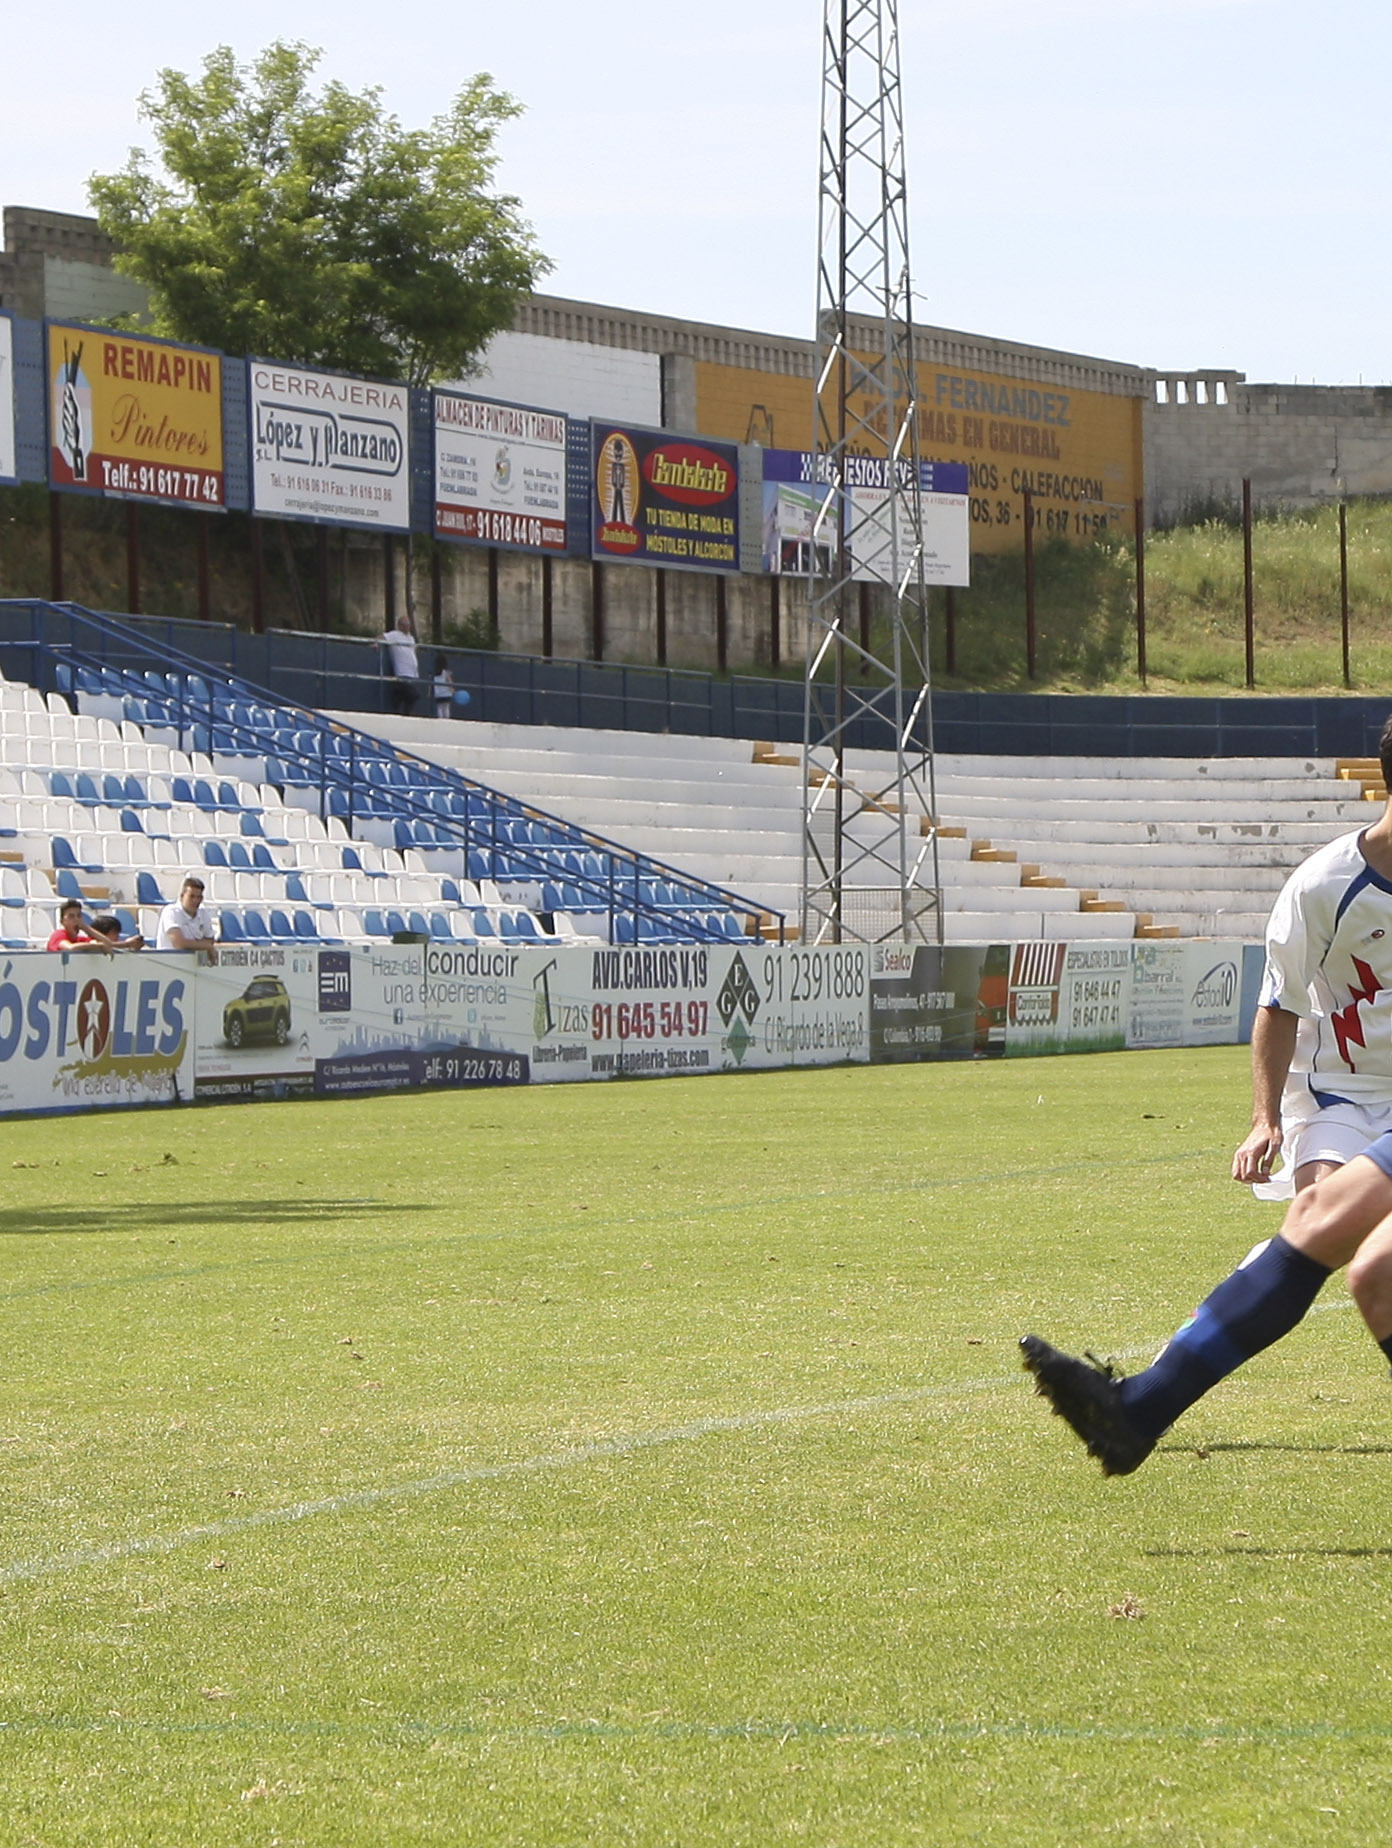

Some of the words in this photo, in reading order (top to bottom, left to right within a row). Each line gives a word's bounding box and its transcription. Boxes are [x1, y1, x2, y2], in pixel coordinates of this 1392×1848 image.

[104, 343, 211, 393] REMAPIN
[255, 371, 403, 411] CERRAJERIA
[936, 374, 1072, 427] FERNANDEZ
[111, 394, 209, 455] Pintores
[256, 401, 303, 461] López
[310, 425, 318, 467] y
[324, 412, 397, 467] Manzano
[963, 416, 984, 449] EN
[988, 420, 1060, 461] GENERAL
[102, 461, 137, 490] Telf.:
[139, 466, 155, 492] 91
[158, 469, 180, 495] 617
[184, 473, 199, 499] 77
[202, 475, 218, 501] 42
[477, 511, 489, 538] 91
[492, 513, 512, 541] 618
[514, 516, 527, 544] 44
[996, 500, 1010, 525] 36
[372, 955, 398, 976] Haz
[402, 955, 422, 975] del
[428, 946, 519, 977] conducir
[764, 955, 782, 1003] 91
[790, 951, 864, 1001] 2391888
[383, 984, 414, 1004] una
[419, 980, 507, 1008] experiencia
[1074, 982, 1082, 1002] 91
[592, 1003, 612, 1040] 91
[617, 1002, 655, 1039] 645
[660, 1002, 683, 1038] 54
[687, 1001, 708, 1036] 97
[1073, 1006, 1081, 1027] 91
[446, 1059, 458, 1078] 91
[463, 1060, 486, 1079] 226
[488, 1060, 503, 1078] 78
[506, 1060, 520, 1079] 48
